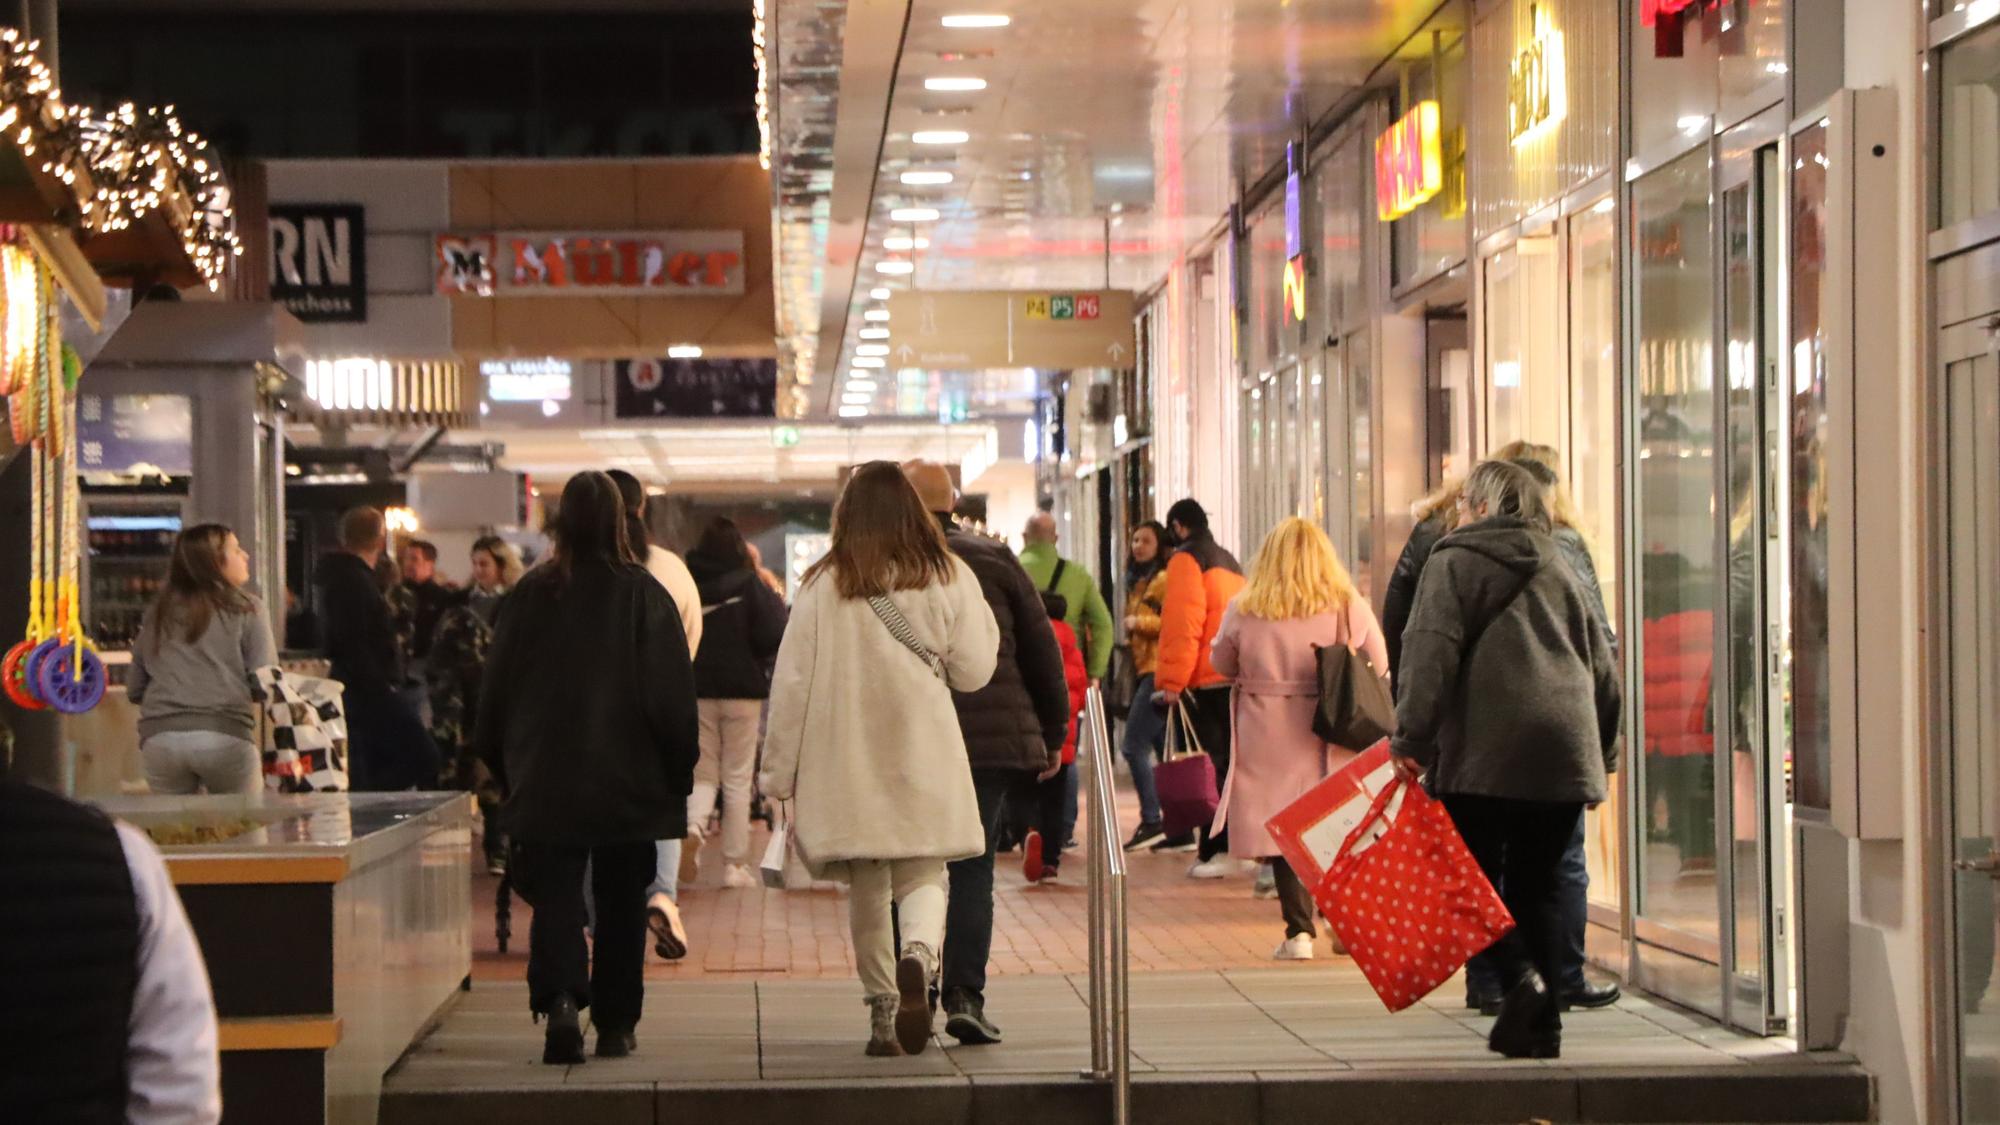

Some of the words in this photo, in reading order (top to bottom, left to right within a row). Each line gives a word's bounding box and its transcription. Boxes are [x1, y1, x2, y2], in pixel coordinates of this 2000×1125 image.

[511, 238, 739, 287] Müller
[1025, 298, 1046, 316] P4
[1051, 298, 1072, 317] P5
[1076, 298, 1098, 317] P6
